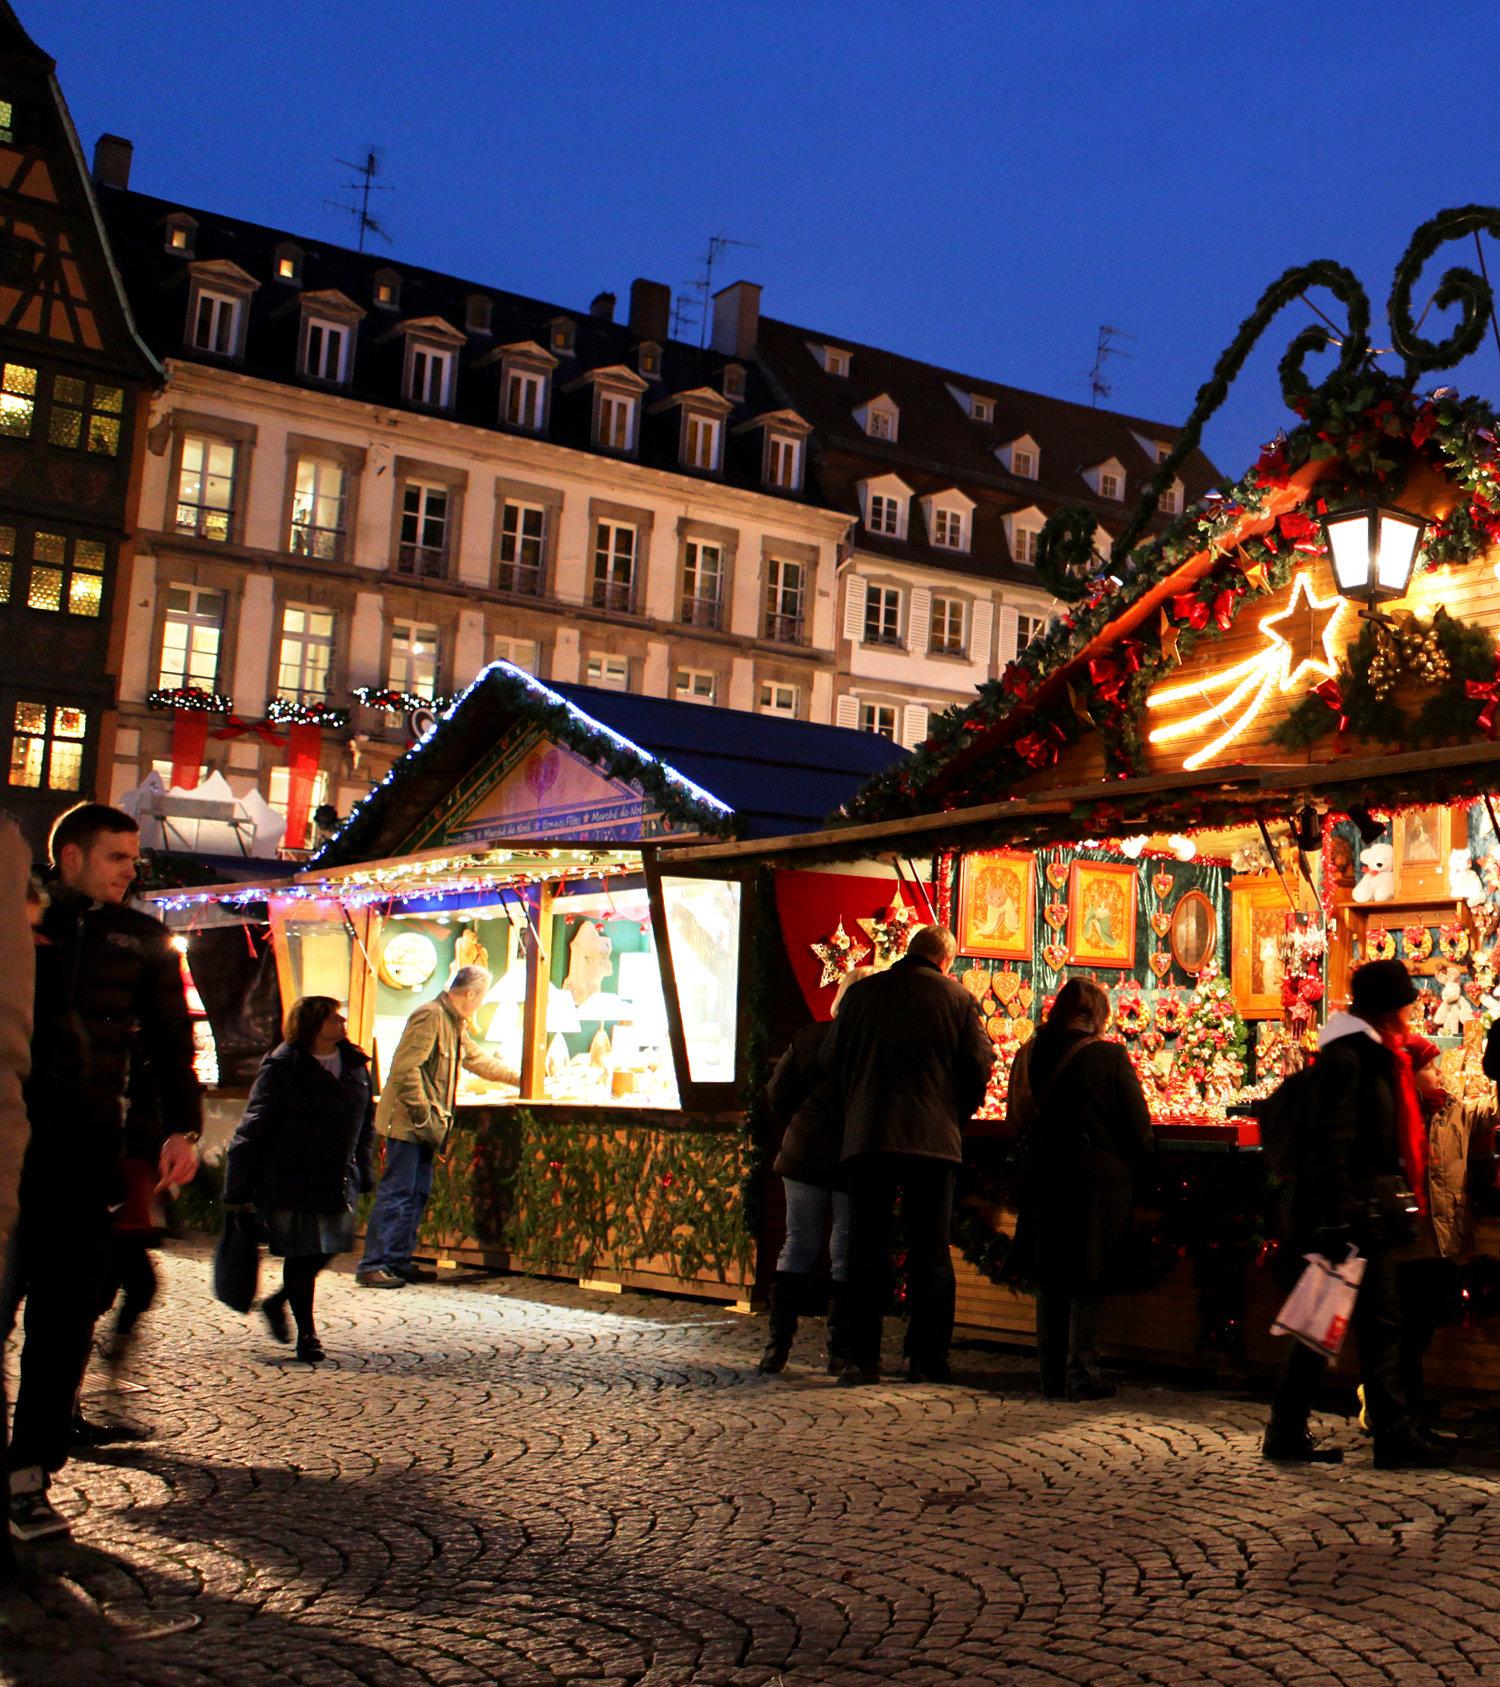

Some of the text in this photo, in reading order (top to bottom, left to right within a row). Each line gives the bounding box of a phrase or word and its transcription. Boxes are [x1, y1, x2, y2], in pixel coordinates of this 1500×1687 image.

[591, 807, 619, 822] Marché
[620, 804, 629, 817] de
[630, 803, 648, 816] Noël
